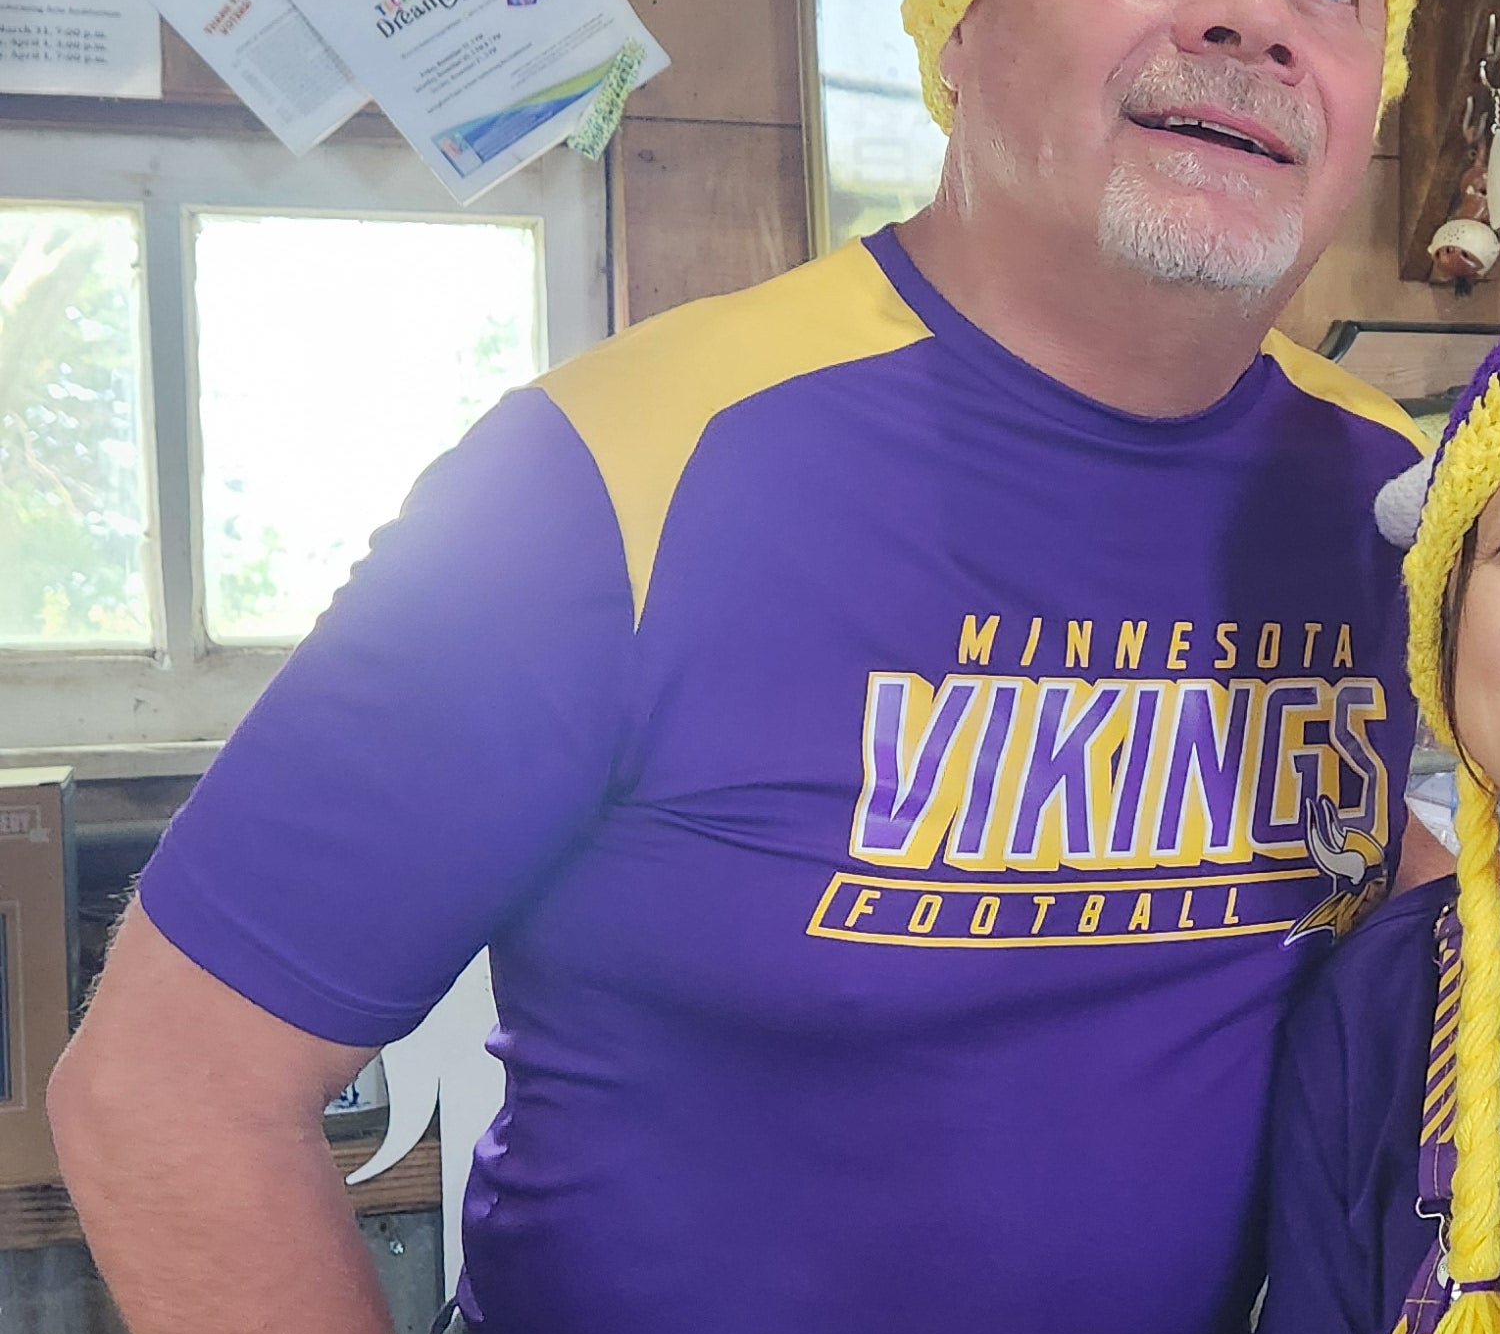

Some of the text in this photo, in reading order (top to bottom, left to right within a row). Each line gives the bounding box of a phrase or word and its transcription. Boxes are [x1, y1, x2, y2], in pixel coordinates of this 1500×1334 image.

[957, 613, 1353, 671] MINNESOTA
[848, 670, 1390, 873] VIKINGS
[845, 886, 1241, 937] FOOTBALL
